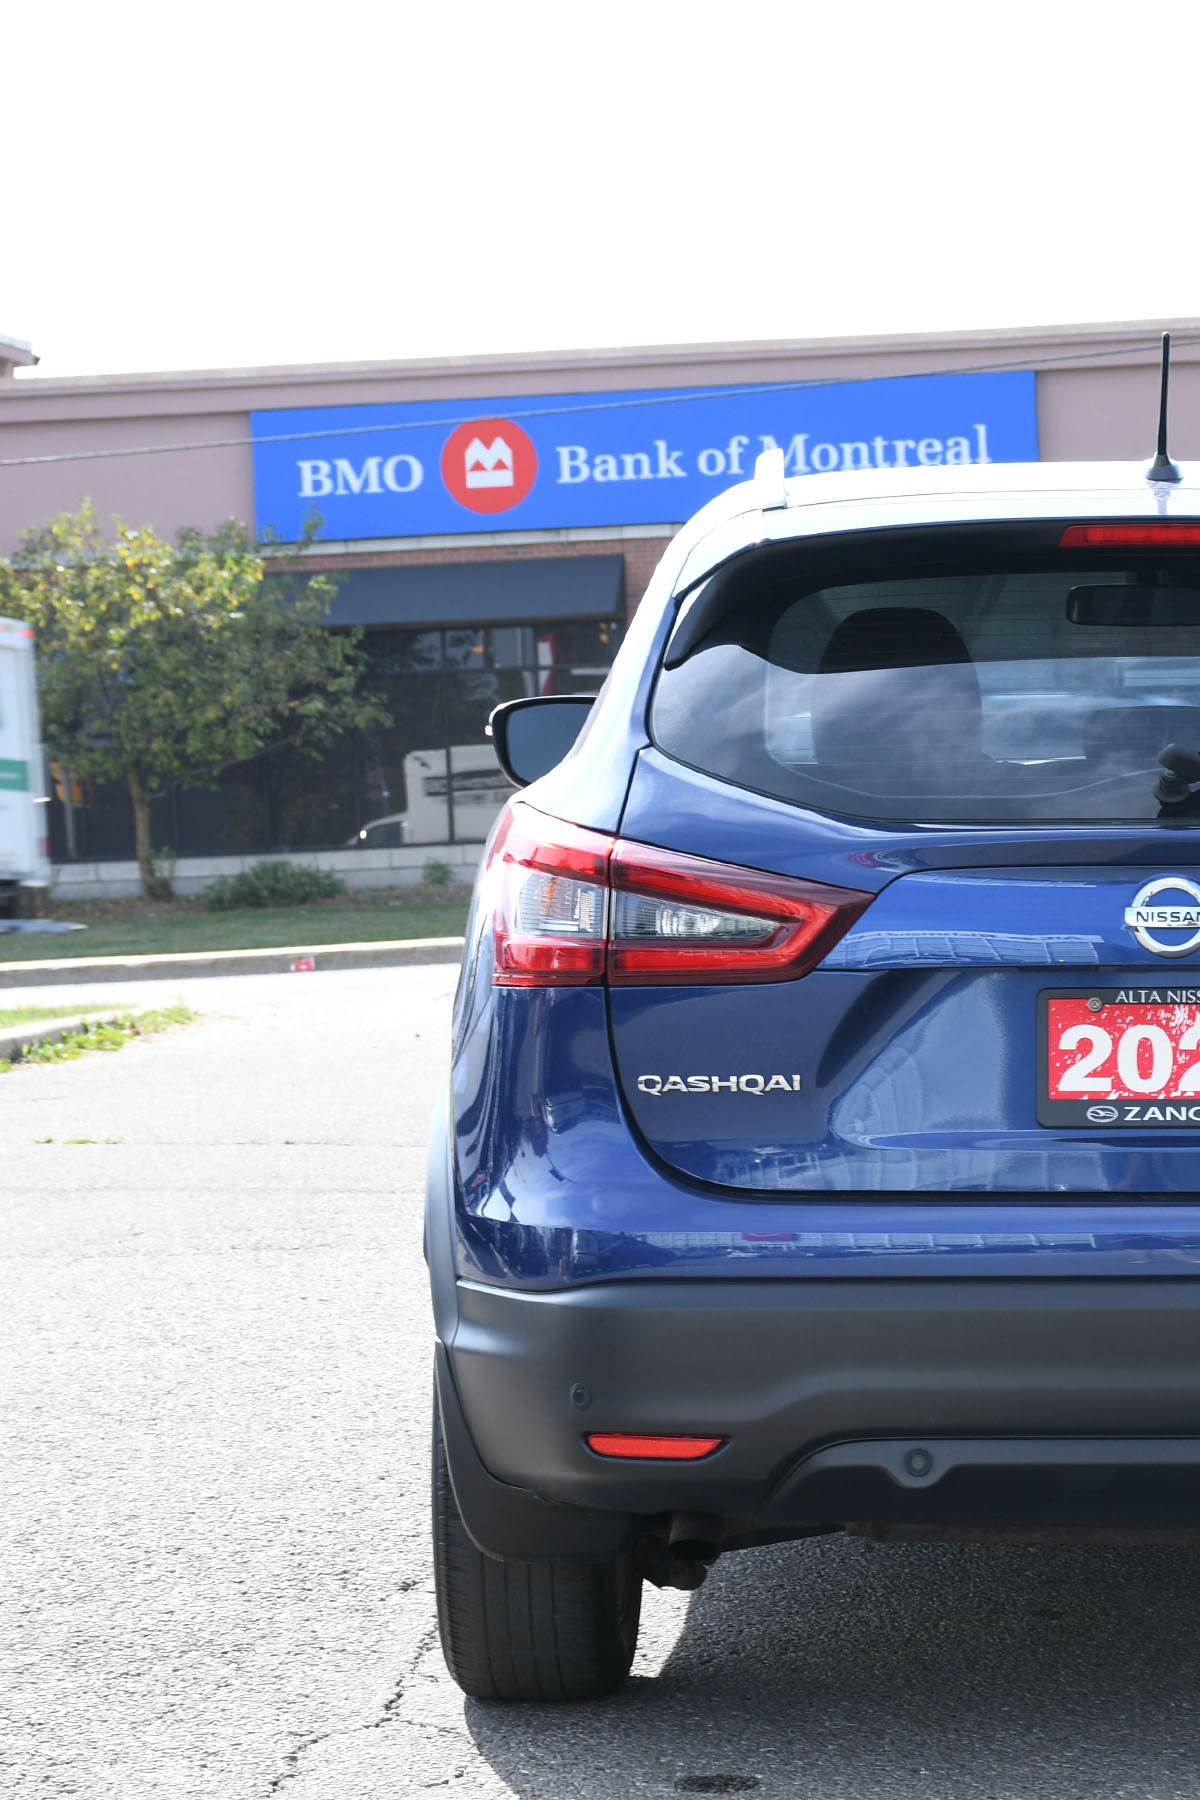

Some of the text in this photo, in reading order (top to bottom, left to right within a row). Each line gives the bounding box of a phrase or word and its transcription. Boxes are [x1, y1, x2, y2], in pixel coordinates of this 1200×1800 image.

[556, 424, 992, 484] Bank of Montreal
[297, 455, 424, 498] BMO
[1115, 990, 1162, 1003] ALTA
[637, 1074, 801, 1096] QASHQAI
